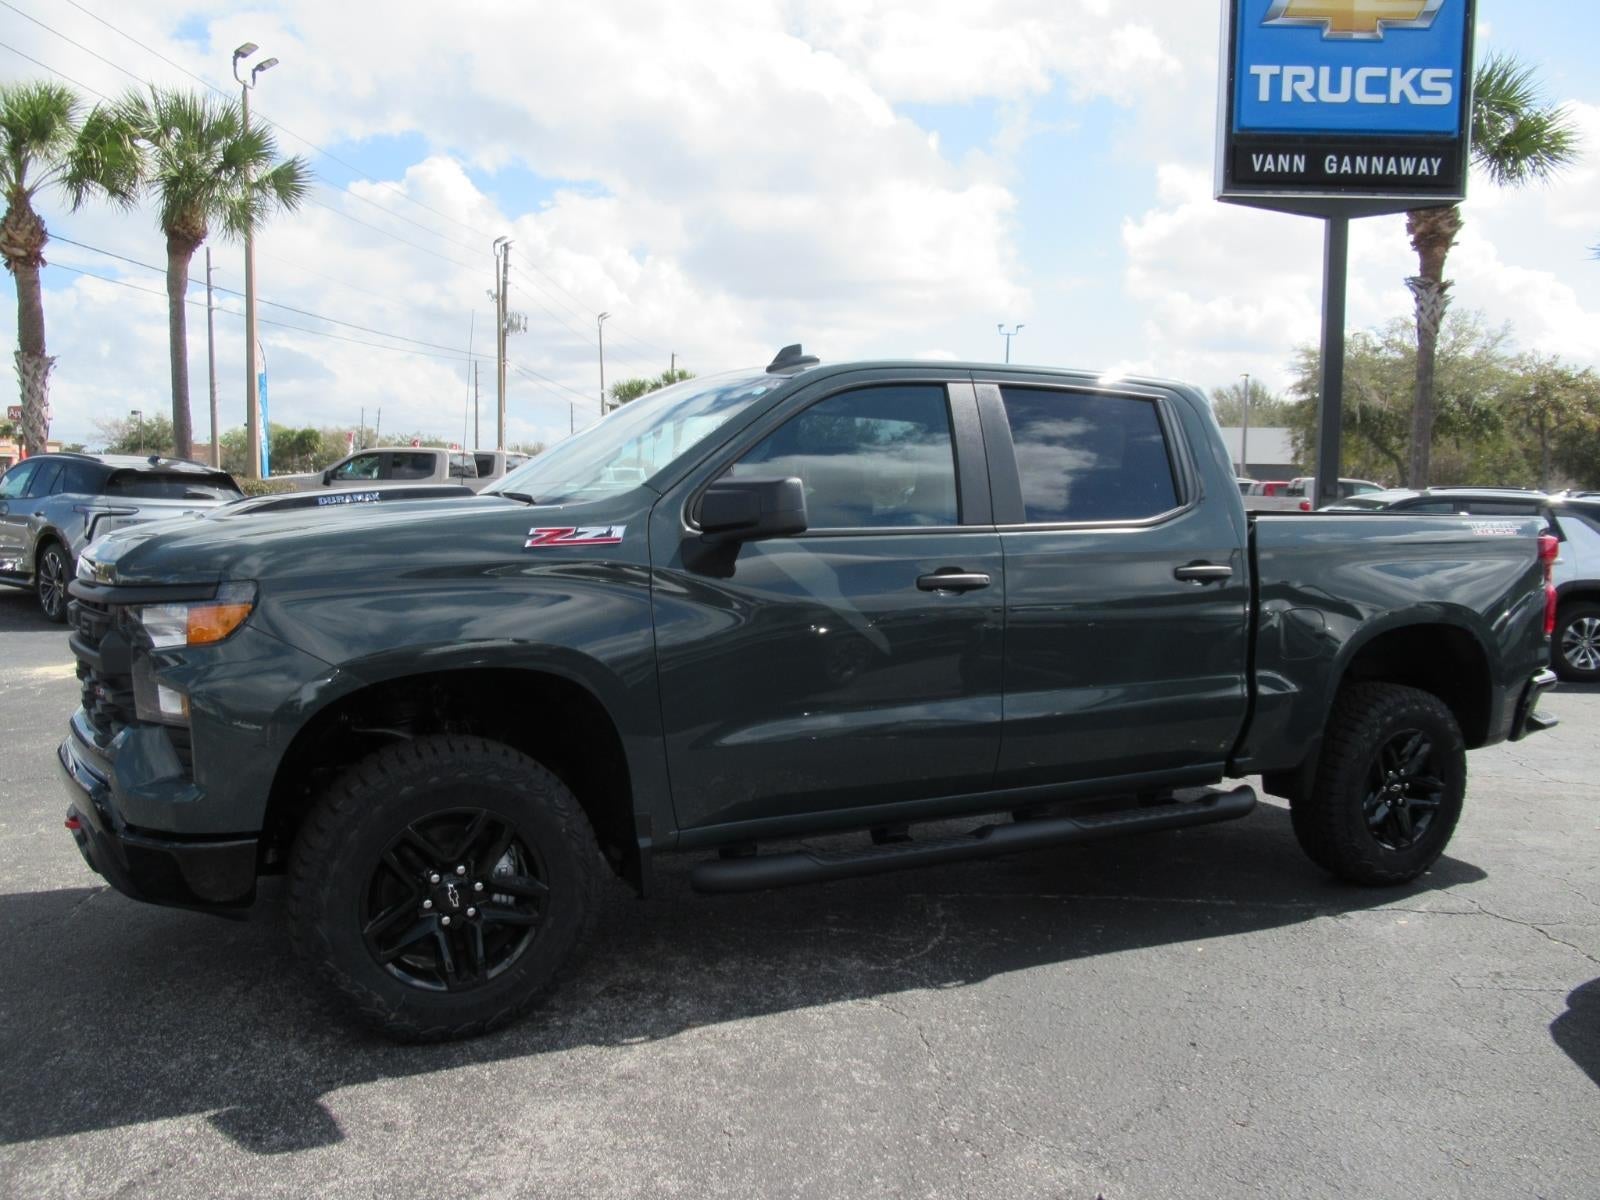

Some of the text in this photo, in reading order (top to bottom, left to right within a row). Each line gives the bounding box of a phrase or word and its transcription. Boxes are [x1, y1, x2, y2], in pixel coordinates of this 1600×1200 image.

[1250, 65, 1453, 105] TRUCKS
[1252, 154, 1442, 176] VANN GANNAWAY
[319, 492, 380, 505] DURAMAX
[525, 525, 627, 548] Z71
